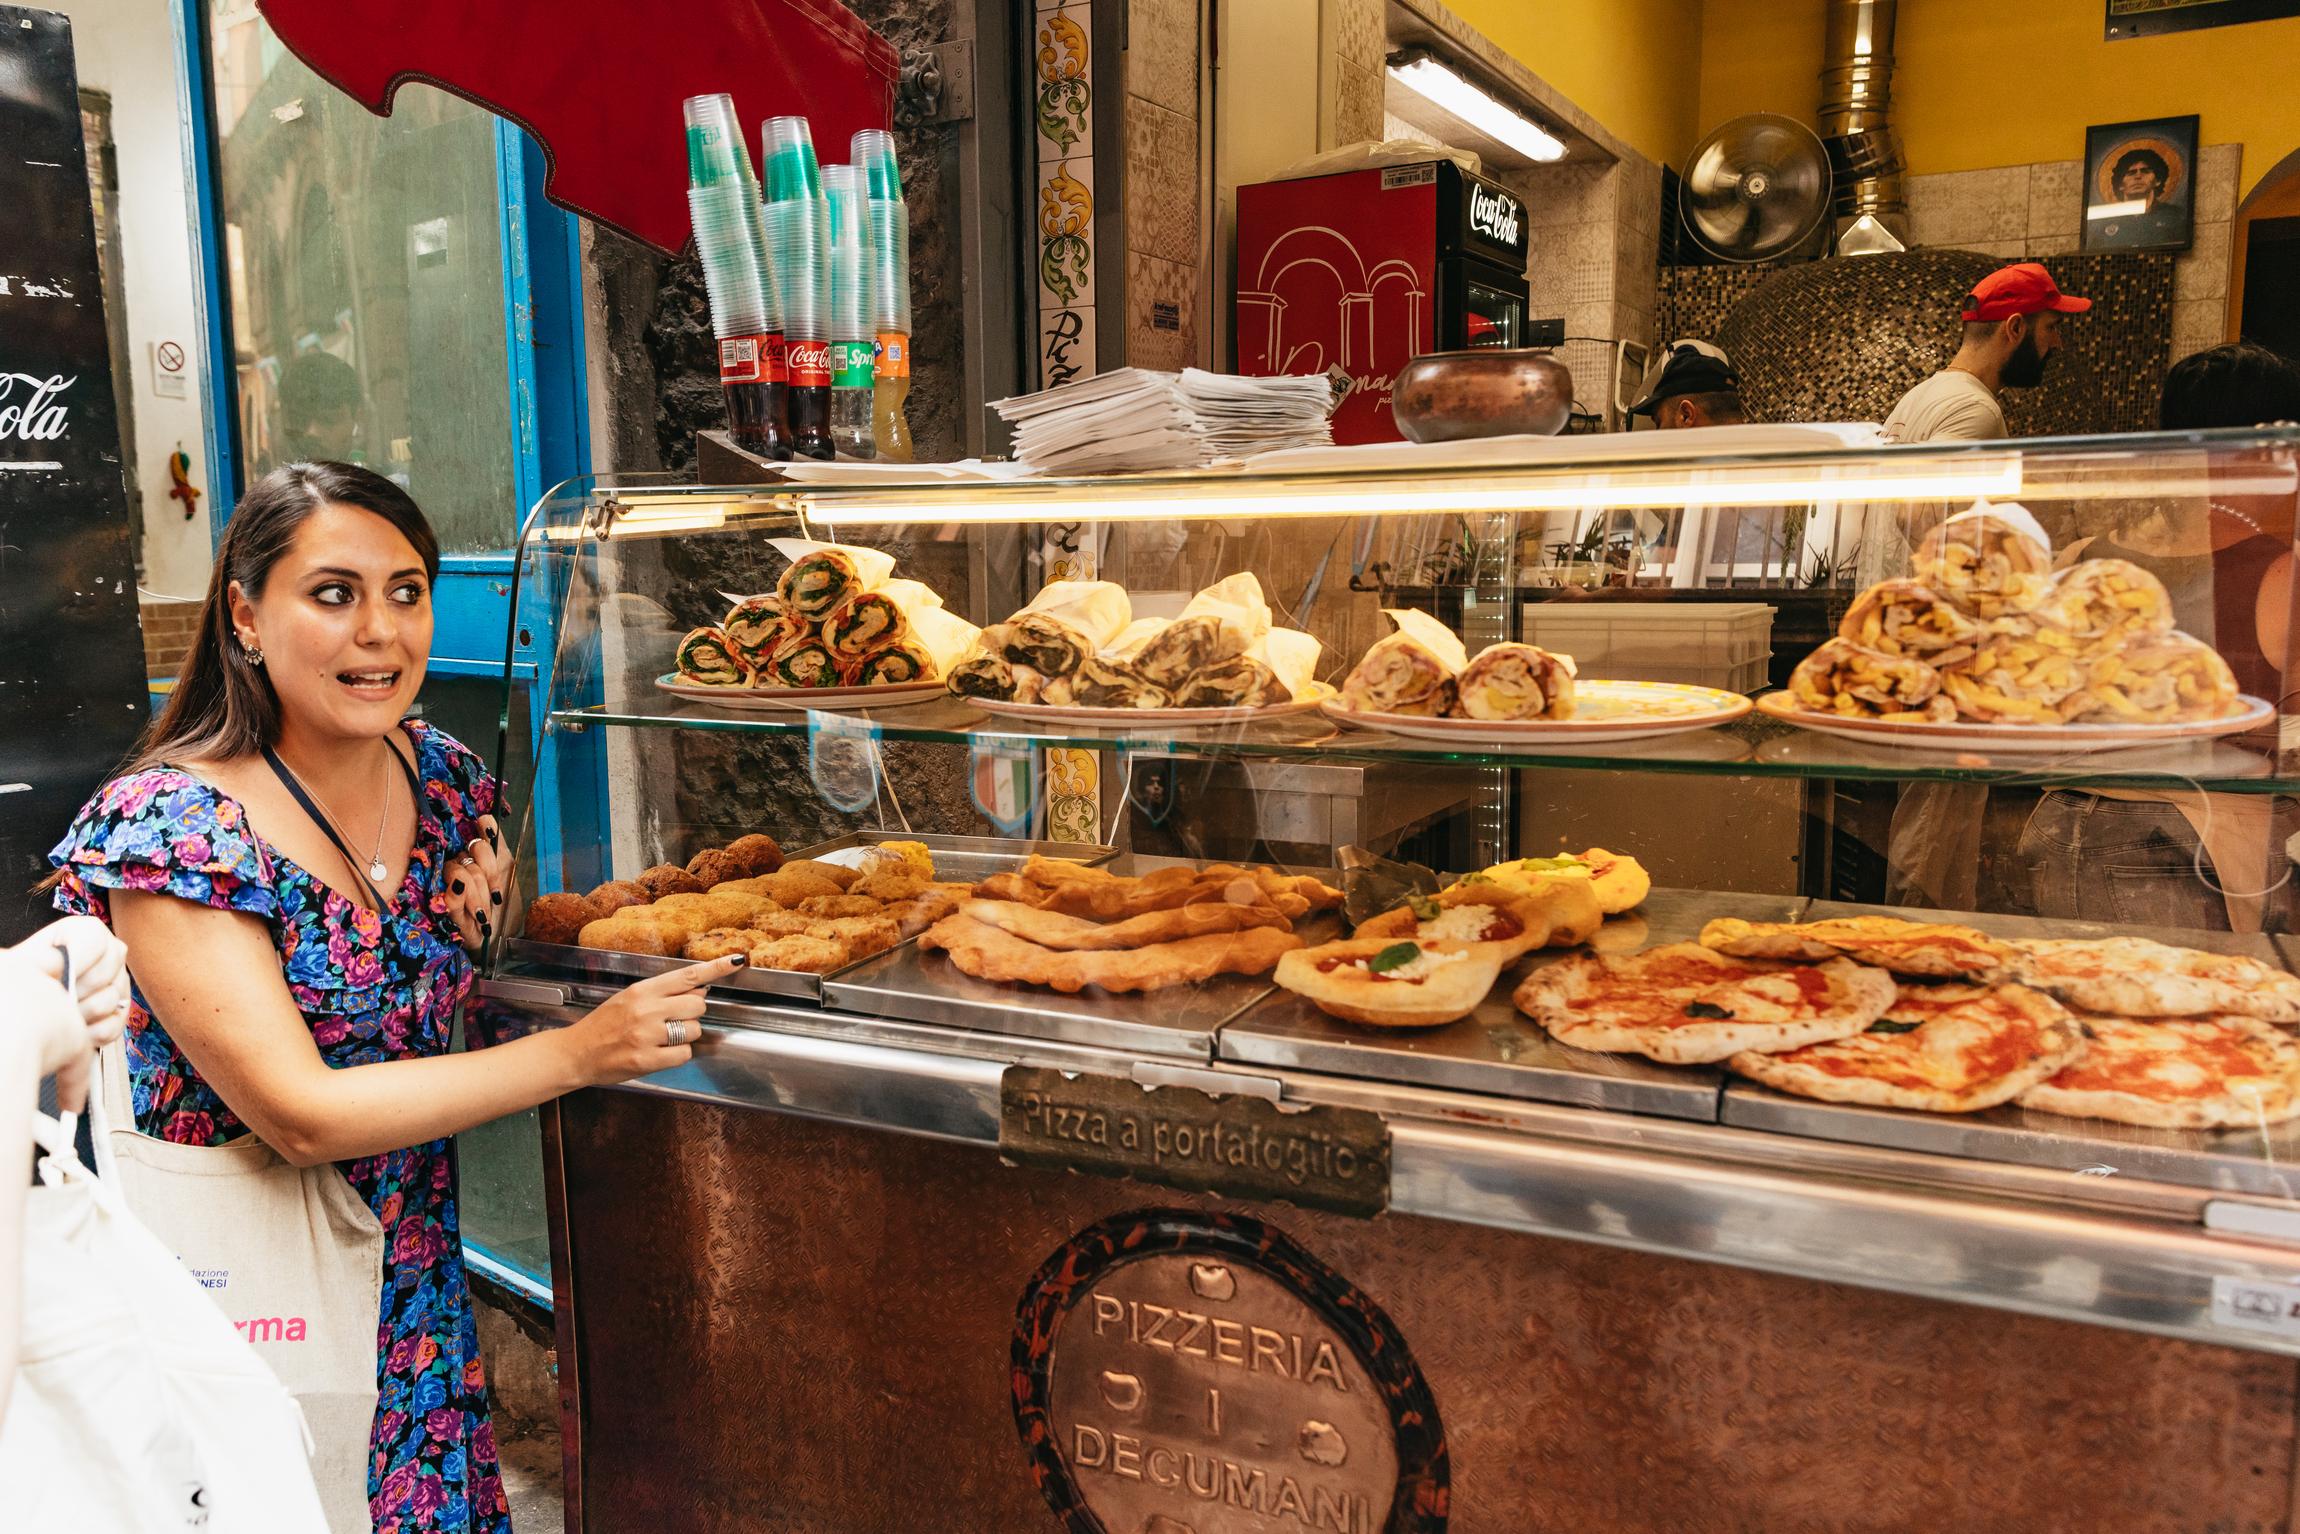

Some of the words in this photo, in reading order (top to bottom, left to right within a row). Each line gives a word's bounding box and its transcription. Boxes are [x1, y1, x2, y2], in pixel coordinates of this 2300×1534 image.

[1470, 183, 1518, 246] Coca-Cola
[1023, 1092, 1108, 1146] Pizza
[1121, 1116, 1139, 1150] a
[196, 1278, 227, 1289] NESI
[1092, 1293, 1347, 1392] PIZZERIA
[1073, 1423, 1370, 1534] DECUMANI
